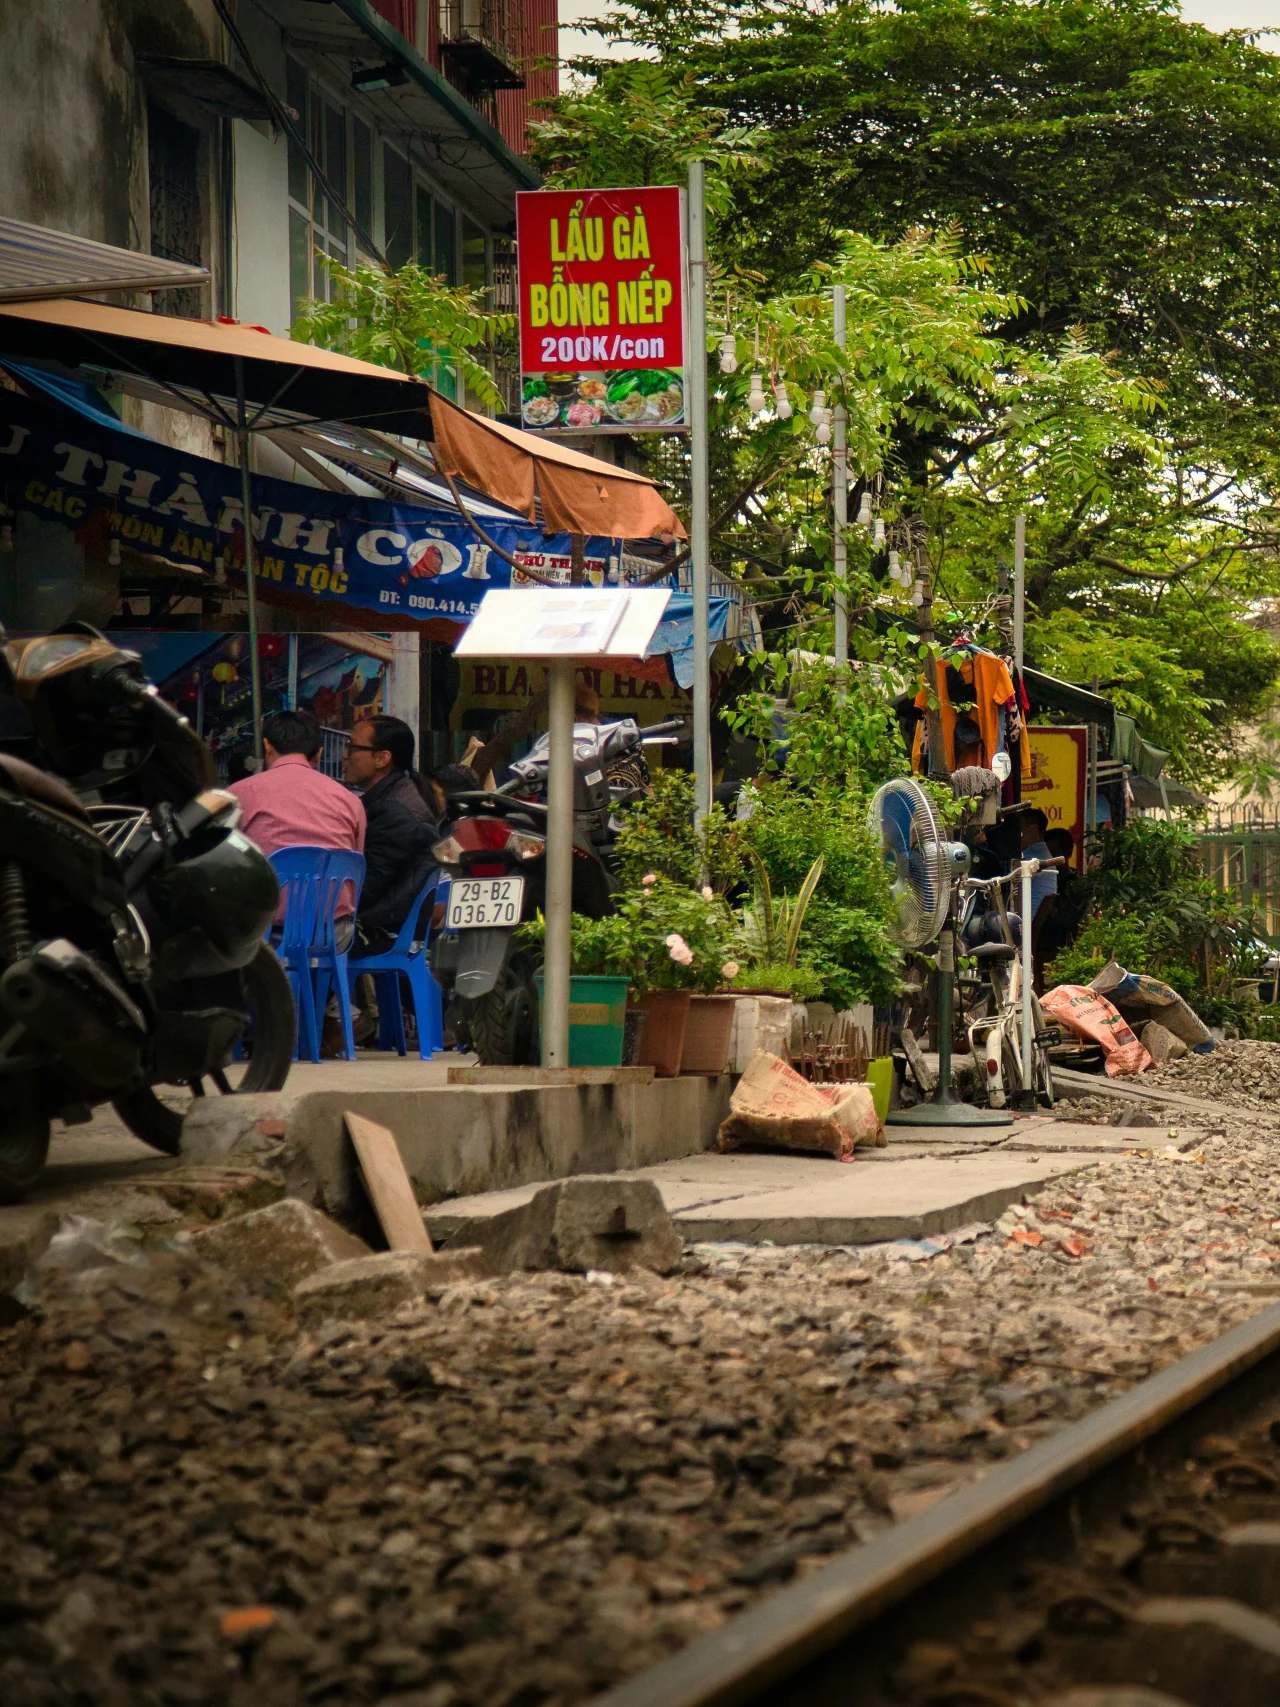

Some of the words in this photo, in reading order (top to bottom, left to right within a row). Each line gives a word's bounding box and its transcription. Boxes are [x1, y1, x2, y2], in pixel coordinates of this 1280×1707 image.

[550, 199, 604, 262] LẨU
[612, 206, 651, 261] GÀ
[530, 266, 610, 328] BỖNG
[617, 264, 673, 326] NẾP
[541, 335, 665, 363] 200K/con
[53, 441, 341, 556] THÀNH
[294, 561, 349, 595] TỘC
[514, 554, 546, 568] PHÚ
[549, 557, 604, 572] THNH
[408, 595, 480, 615] 090.414.5
[472, 664, 534, 697] BIA
[460, 881, 511, 902] 29-B2
[452, 902, 515, 925] 036.70
